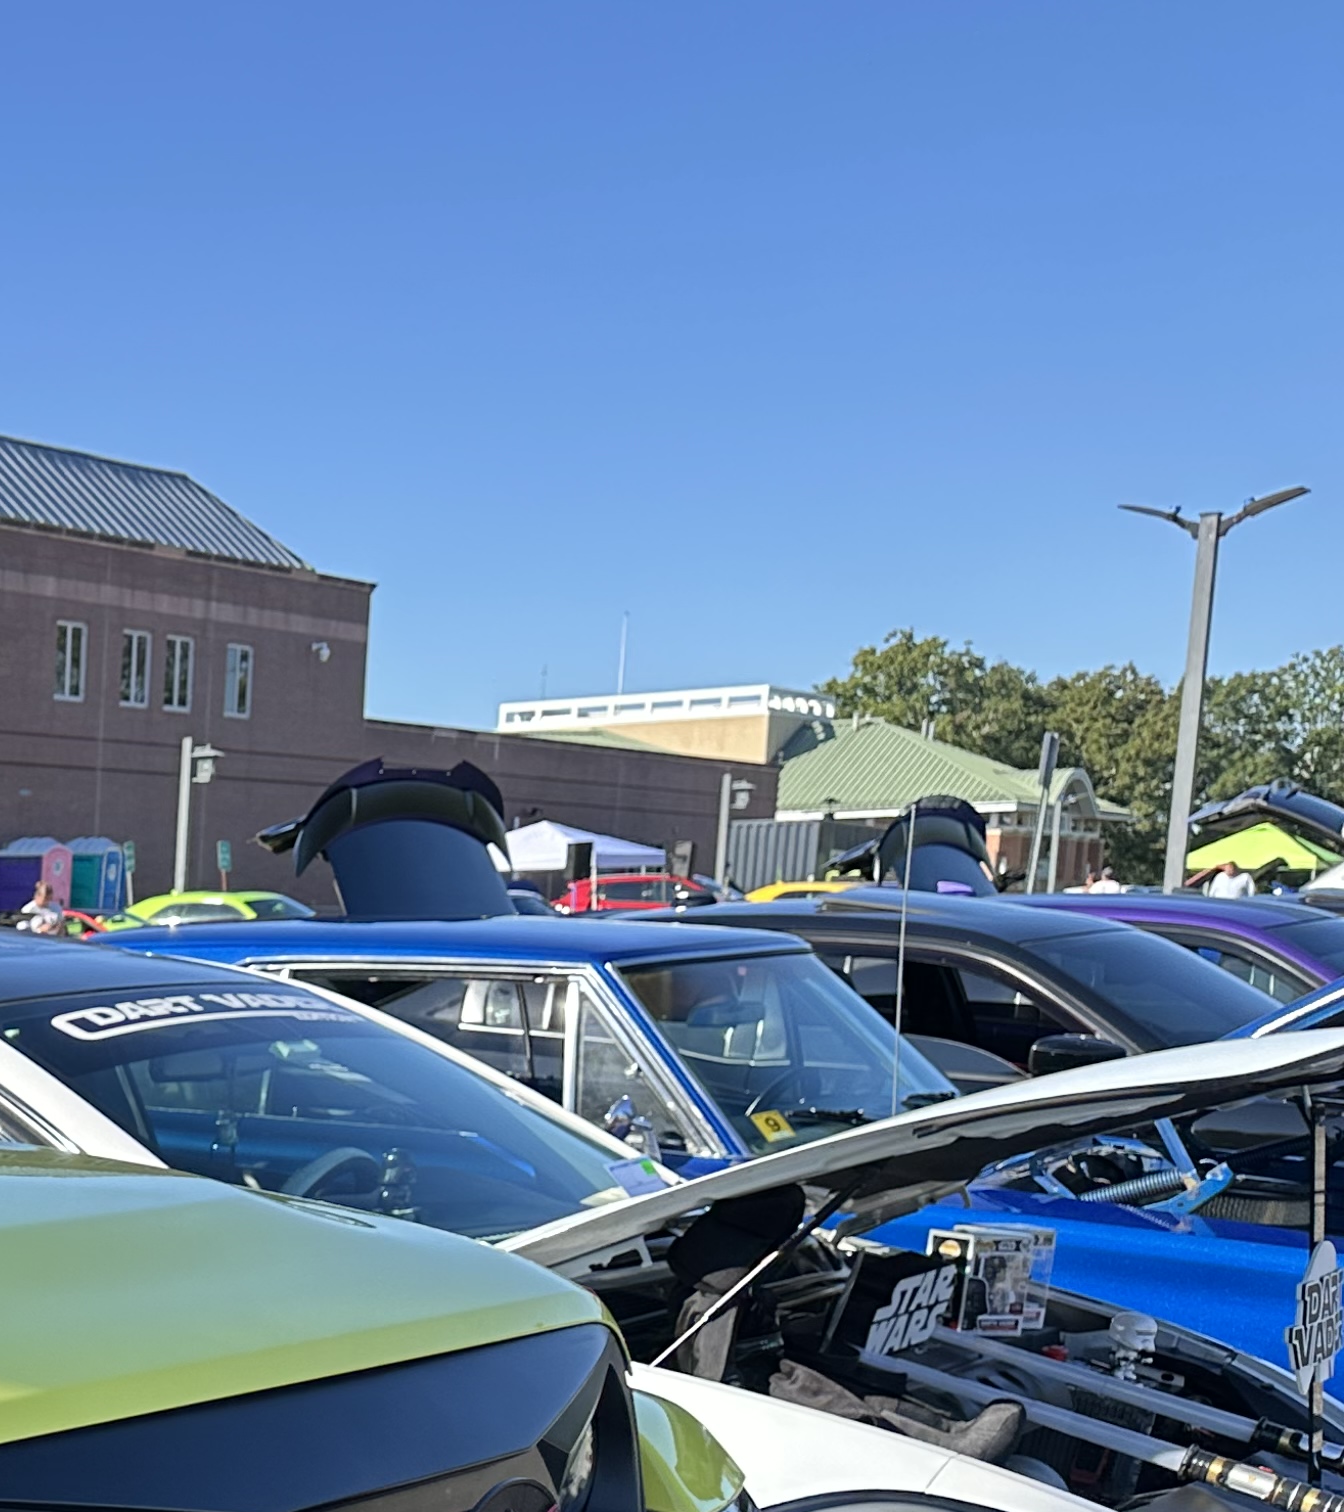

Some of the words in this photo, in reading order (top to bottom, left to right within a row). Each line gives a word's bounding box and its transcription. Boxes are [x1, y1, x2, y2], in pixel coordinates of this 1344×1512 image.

[77, 994, 205, 1027] DART
[764, 1116, 781, 1132] 9
[873, 1264, 957, 1323] STAR
[865, 1301, 949, 1355] WARS
